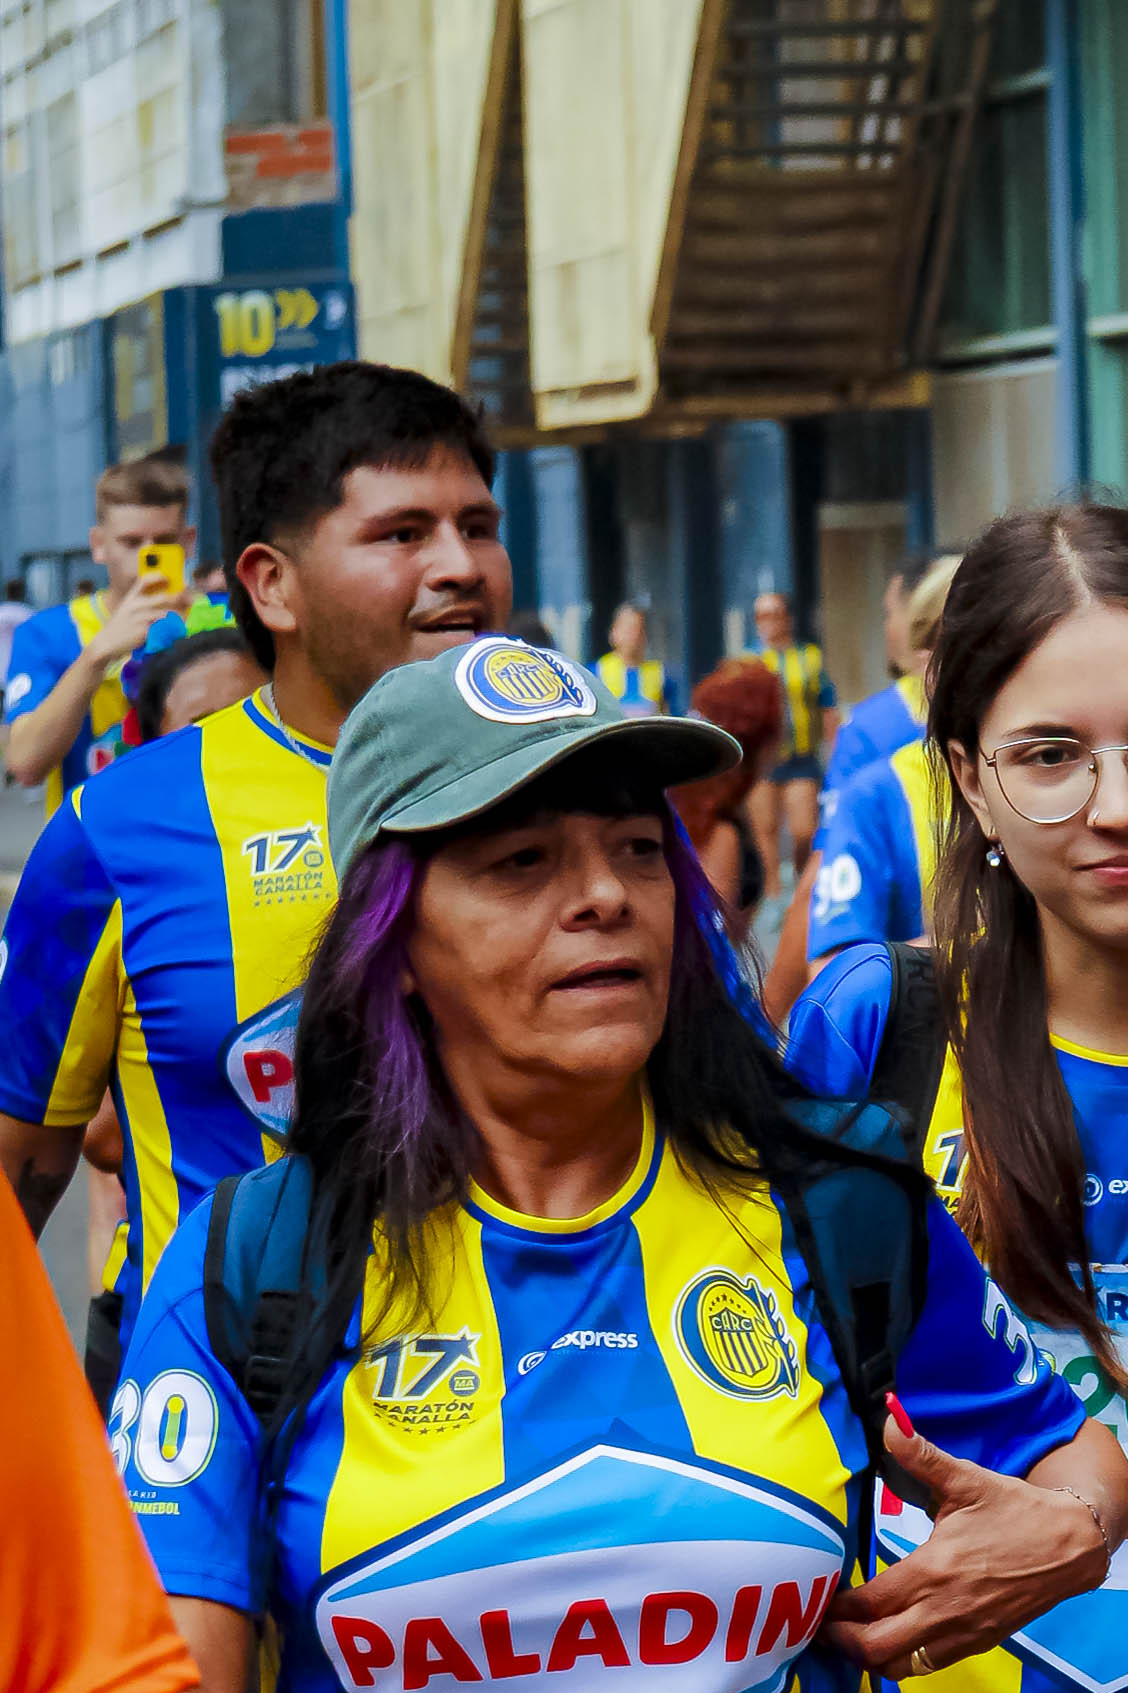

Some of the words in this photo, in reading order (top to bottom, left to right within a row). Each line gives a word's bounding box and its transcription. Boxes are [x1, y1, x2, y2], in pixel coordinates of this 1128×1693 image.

[245, 828, 320, 874] 17
[711, 1311, 753, 1331] CARC
[366, 1335, 480, 1400] 17
